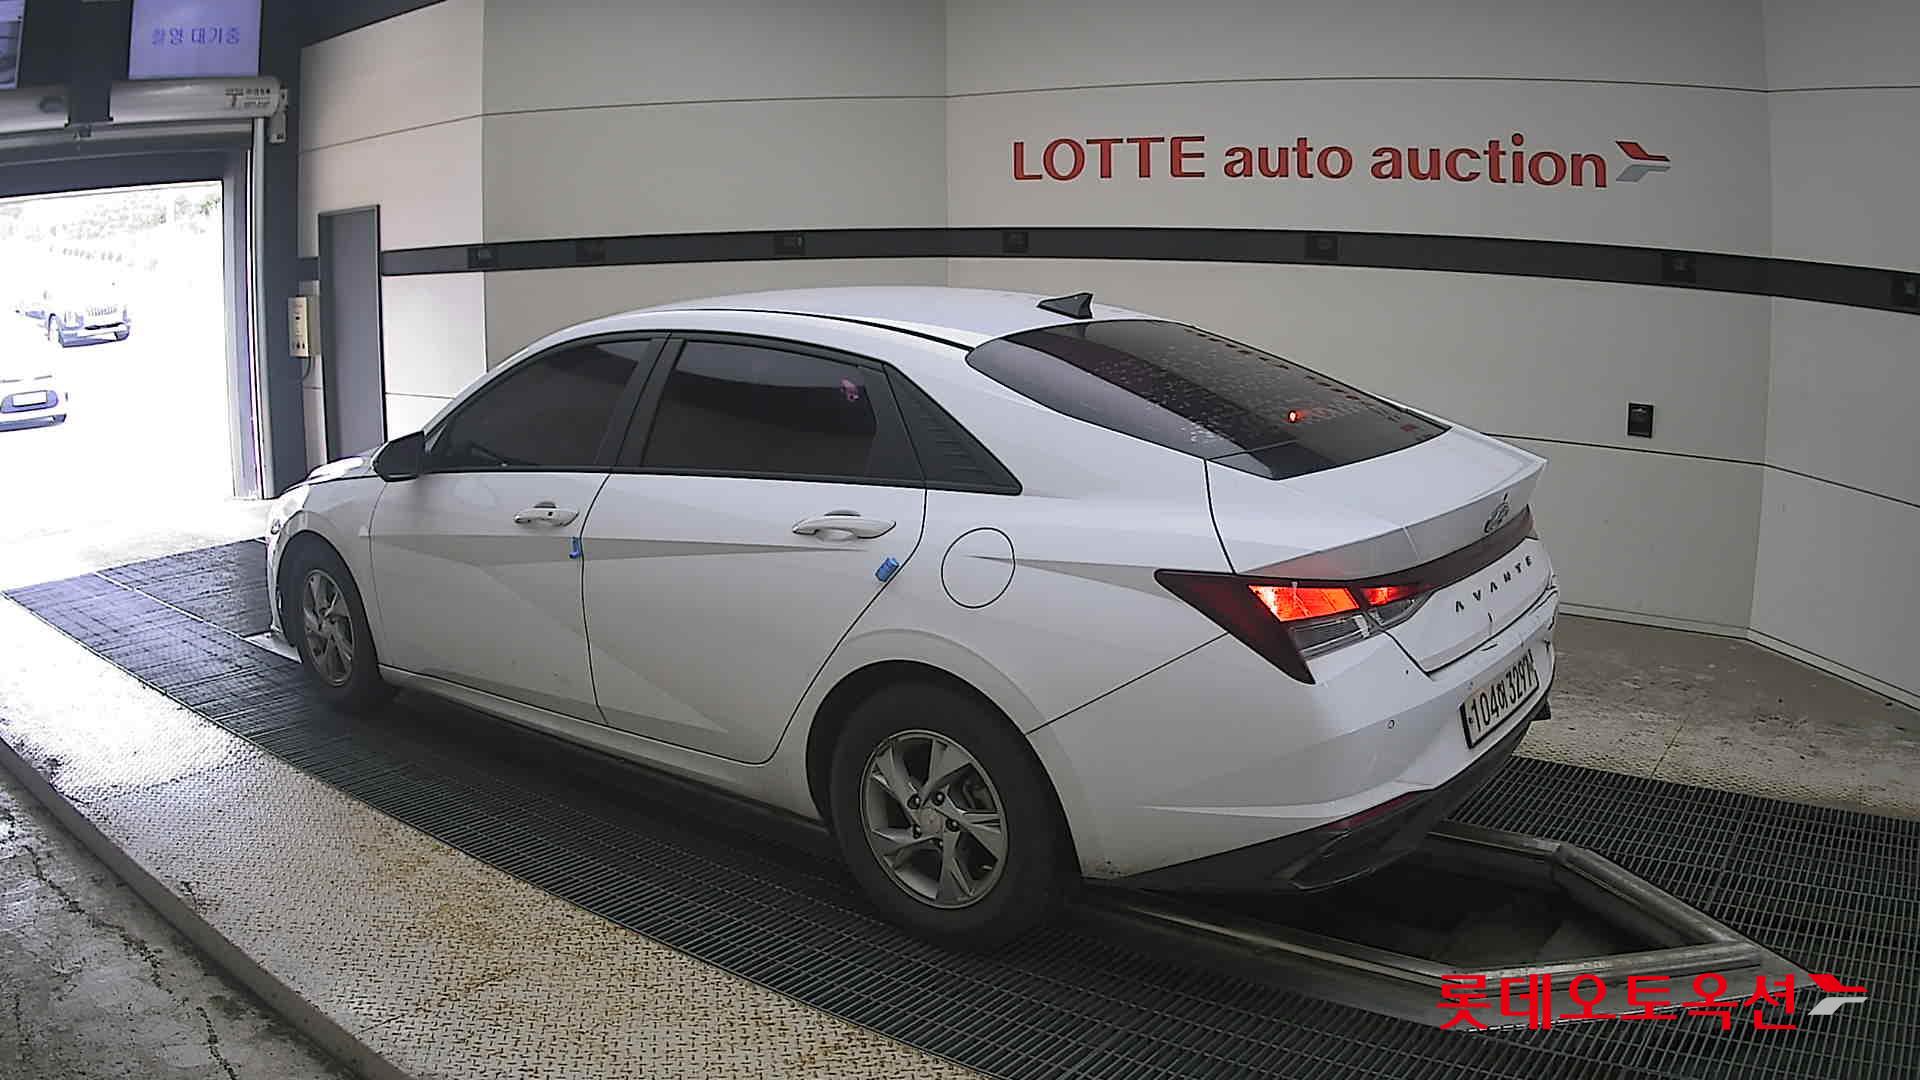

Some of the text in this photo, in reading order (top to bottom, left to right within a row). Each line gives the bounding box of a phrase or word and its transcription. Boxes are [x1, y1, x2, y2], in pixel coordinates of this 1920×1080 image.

[1012, 132, 1607, 188] LOTTE auto auction
[1455, 555, 1532, 613] AVANTE
